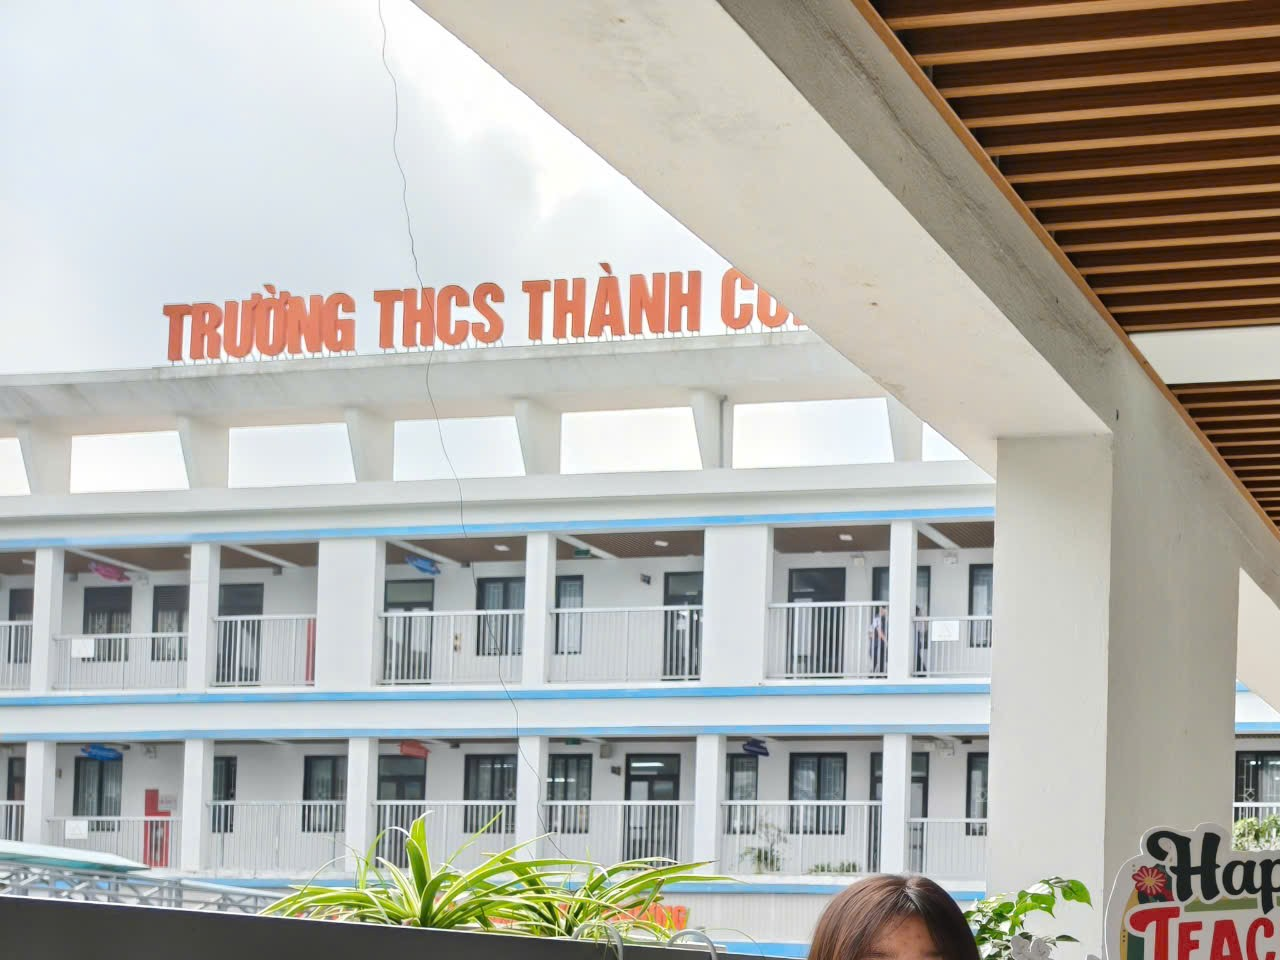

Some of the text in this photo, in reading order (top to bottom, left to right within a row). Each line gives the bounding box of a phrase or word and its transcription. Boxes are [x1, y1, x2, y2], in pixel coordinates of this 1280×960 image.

[163, 284, 356, 361] TRƯỜNG
[373, 282, 505, 351] THCS
[522, 262, 701, 342] THÀNH
